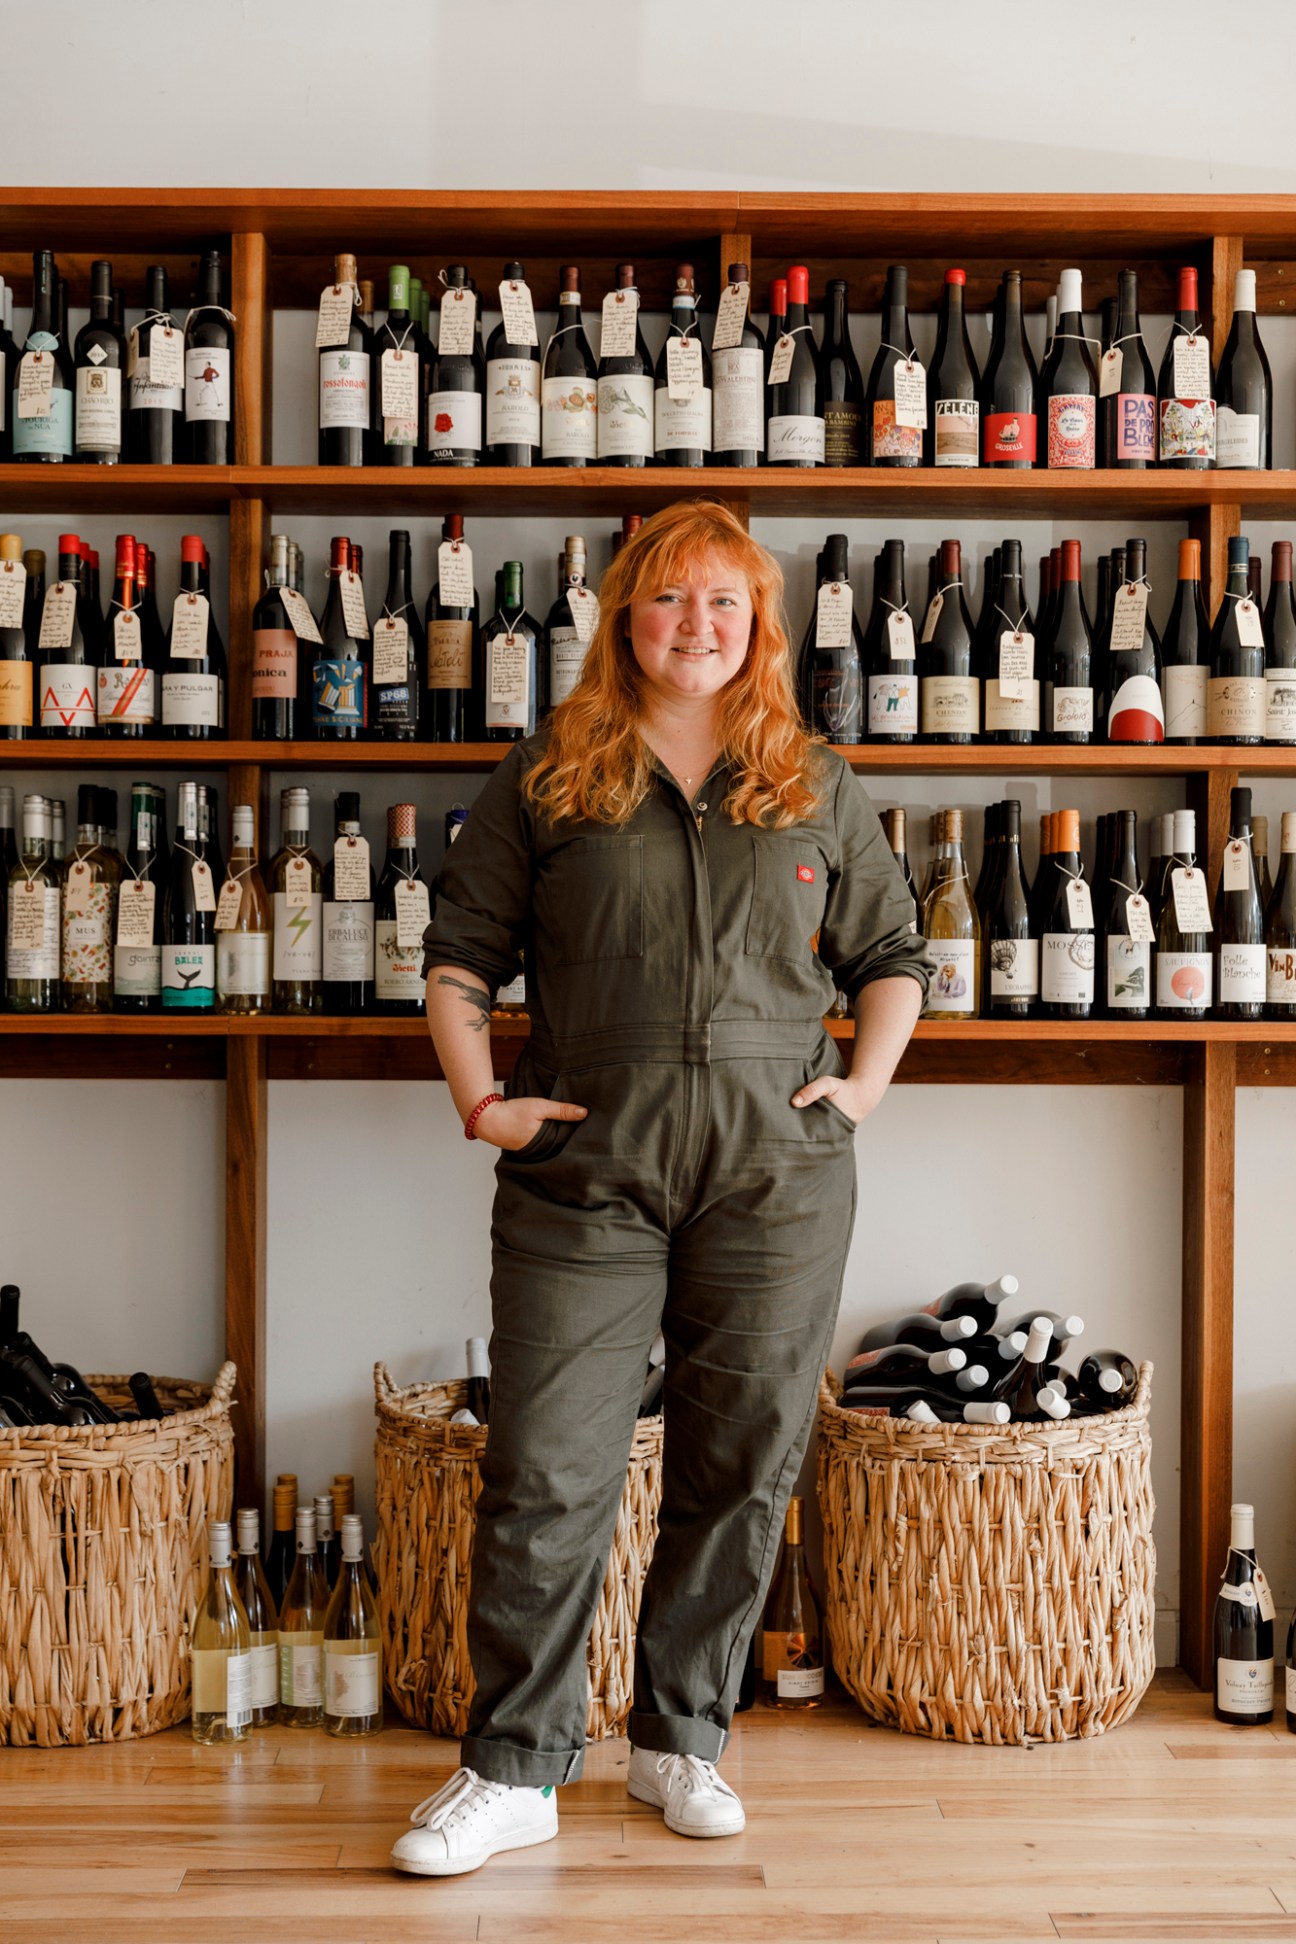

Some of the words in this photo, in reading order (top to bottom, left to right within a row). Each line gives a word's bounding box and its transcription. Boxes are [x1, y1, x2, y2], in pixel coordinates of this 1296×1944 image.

[1124, 399, 1154, 418] PAS
[34, 422, 52, 431] NUA
[1124, 419, 1137, 427] DE
[1140, 419, 1155, 433] PRO
[773, 426, 823, 446] Morgon
[433, 449, 454, 459] NADA
[258, 649, 294, 659] PRAJA
[180, 684, 214, 693] PULGAR
[379, 688, 408, 700] SP68
[936, 708, 967, 716] CHINON
[1220, 708, 1257, 716] CHINON
[1267, 707, 1284, 717] Saint
[75, 927, 97, 935] MUS
[337, 934, 369, 942] CALUSO
[1046, 940, 1091, 951] MOSSE
[1164, 957, 1211, 966] SAUVIGNON
[1222, 954, 1248, 967] Folle
[1223, 966, 1262, 979] Blanche
